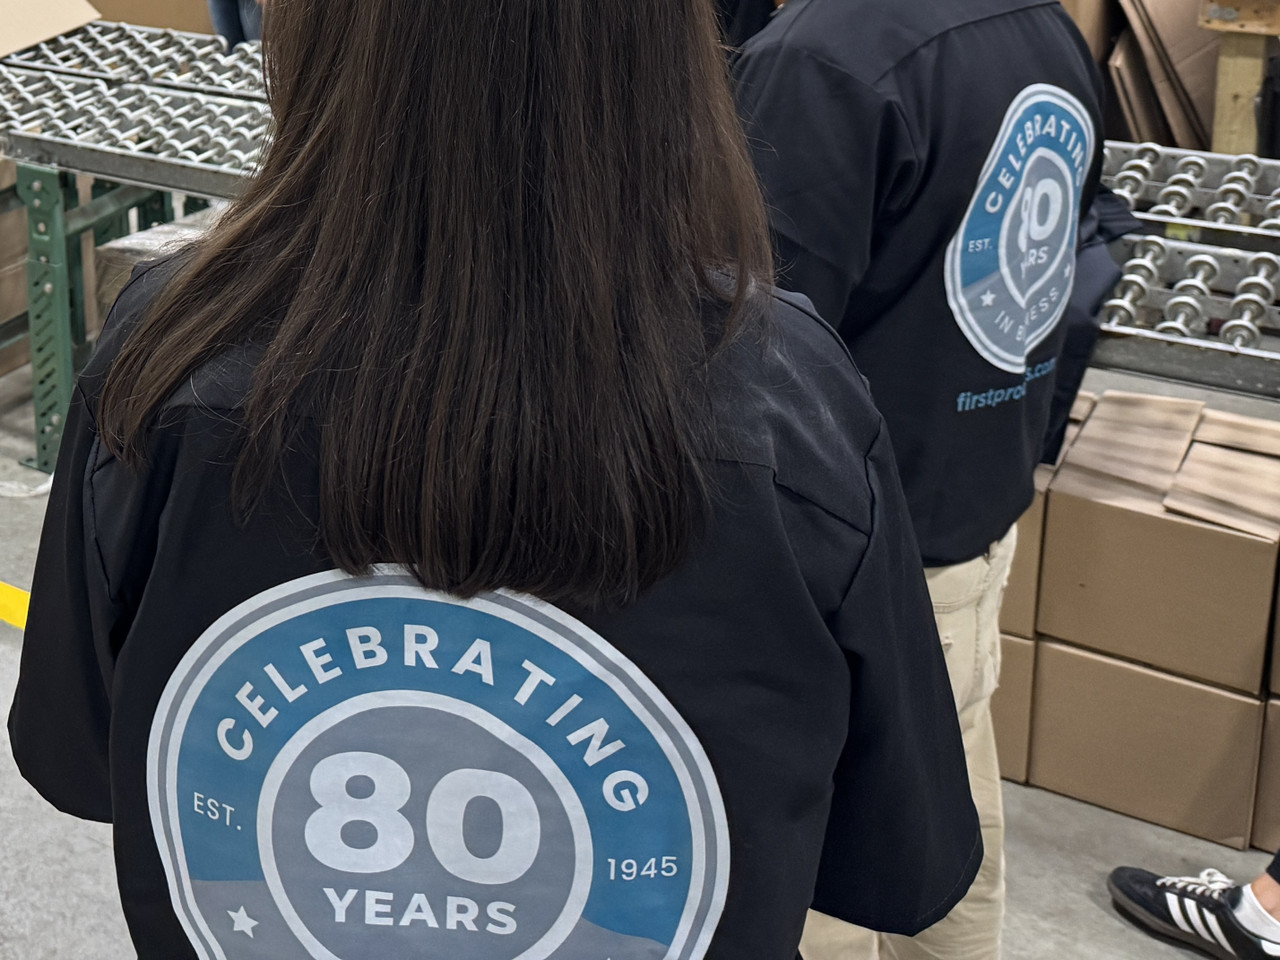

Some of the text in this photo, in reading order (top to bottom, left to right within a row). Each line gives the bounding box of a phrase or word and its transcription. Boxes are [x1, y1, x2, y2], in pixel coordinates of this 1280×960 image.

[968, 237, 993, 253] EST.
[994, 309, 1014, 334] IN
[216, 623, 649, 812] CELEBRATING
[193, 792, 242, 831] EST.
[304, 751, 541, 885] 80
[607, 856, 678, 881] 1945
[323, 887, 518, 936] YEARS
